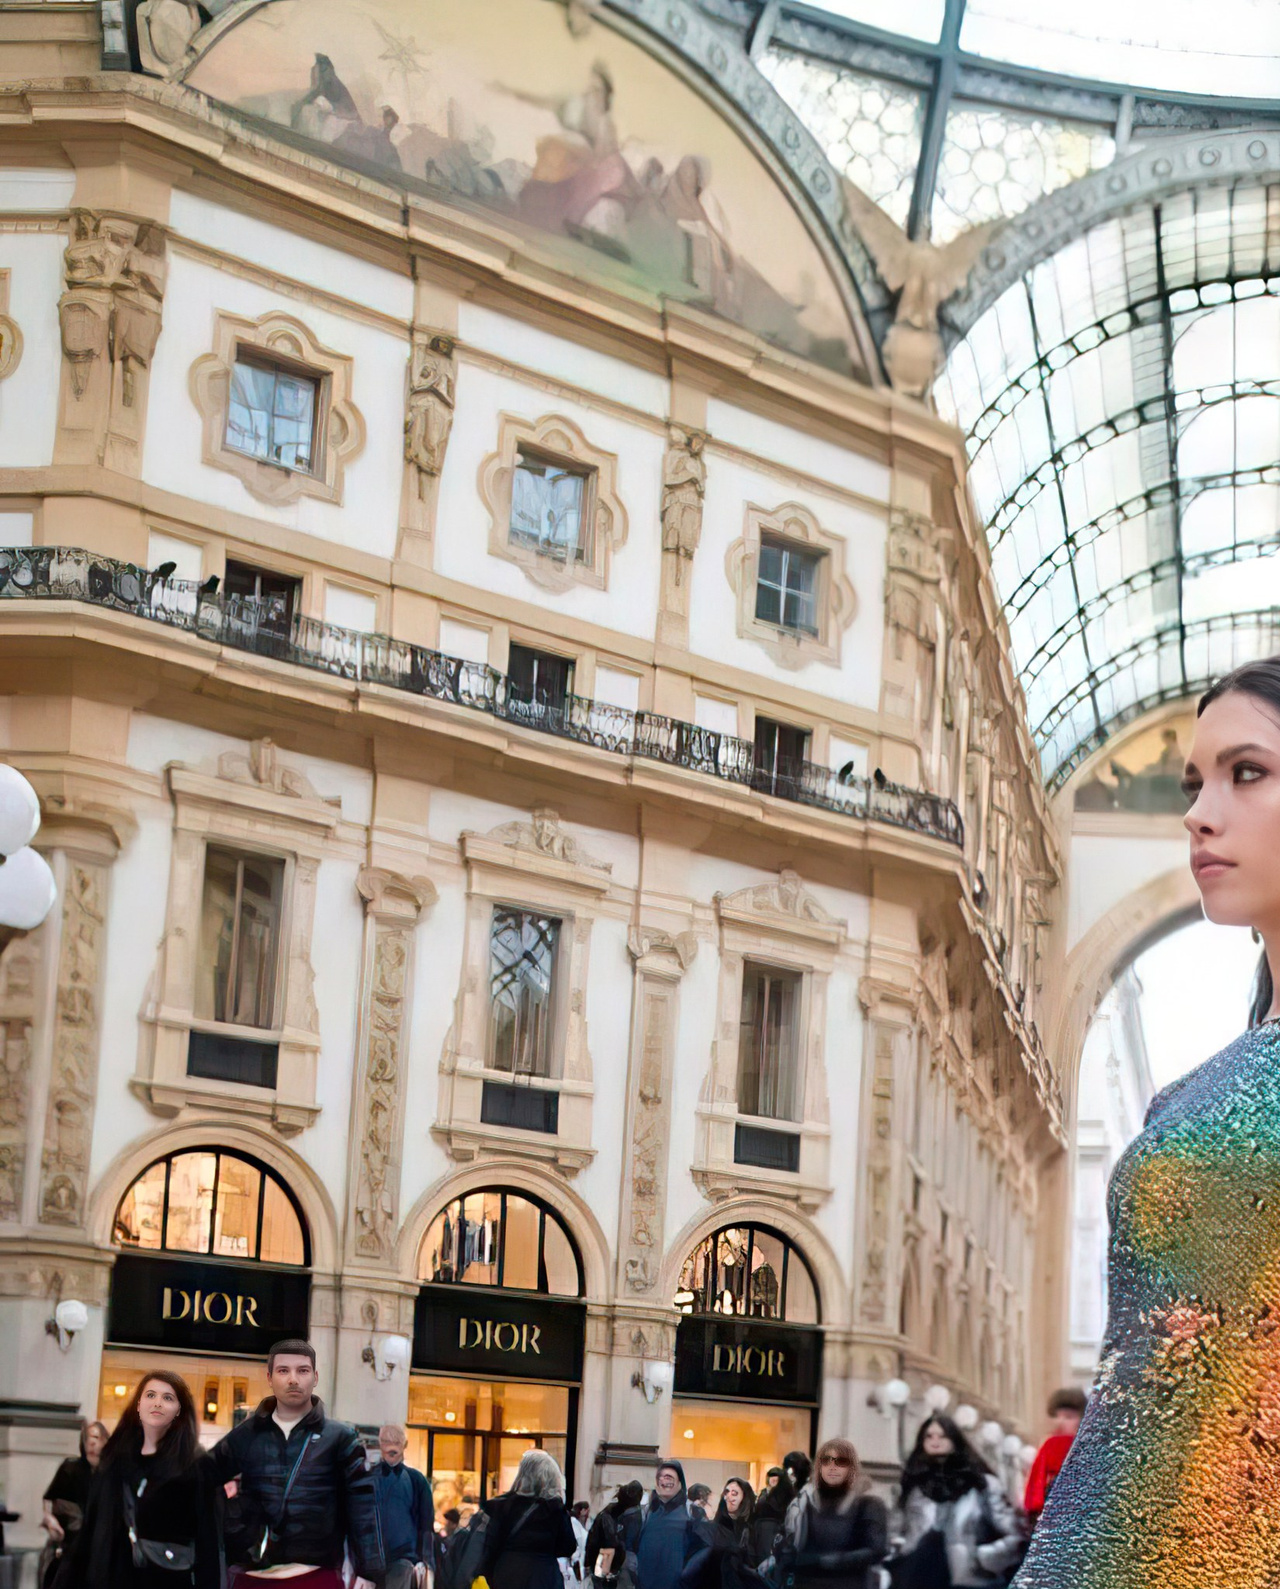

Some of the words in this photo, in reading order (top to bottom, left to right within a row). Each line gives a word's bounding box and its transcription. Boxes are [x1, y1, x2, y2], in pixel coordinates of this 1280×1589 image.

[162, 1287, 260, 1328] DIOR
[459, 1318, 541, 1355] DIOR
[713, 1344, 785, 1377] DIOR
